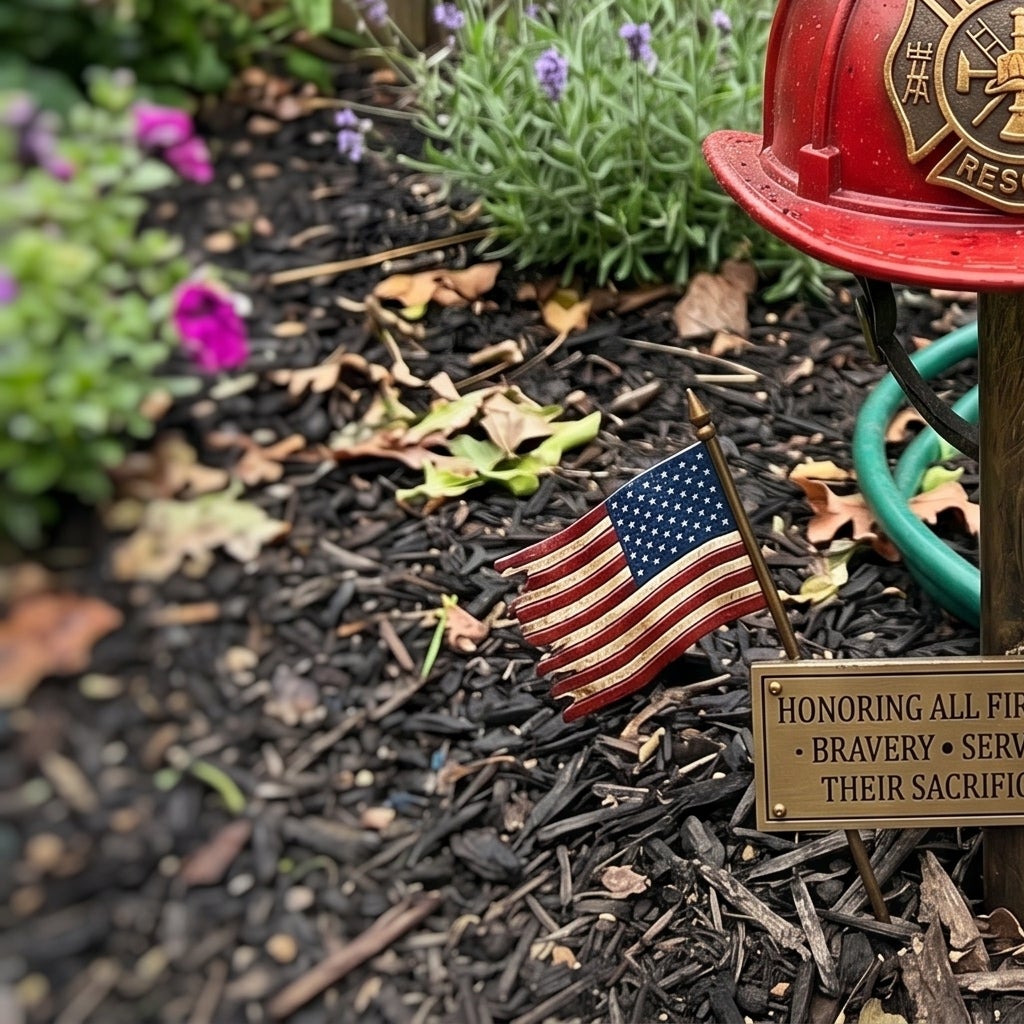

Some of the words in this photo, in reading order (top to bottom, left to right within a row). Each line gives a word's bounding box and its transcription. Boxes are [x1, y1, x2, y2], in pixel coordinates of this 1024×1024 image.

[777, 693, 922, 724] HONORING
[929, 692, 981, 720] ALL
[811, 733, 935, 764] BRAVERY
[820, 774, 906, 803] THEIR
